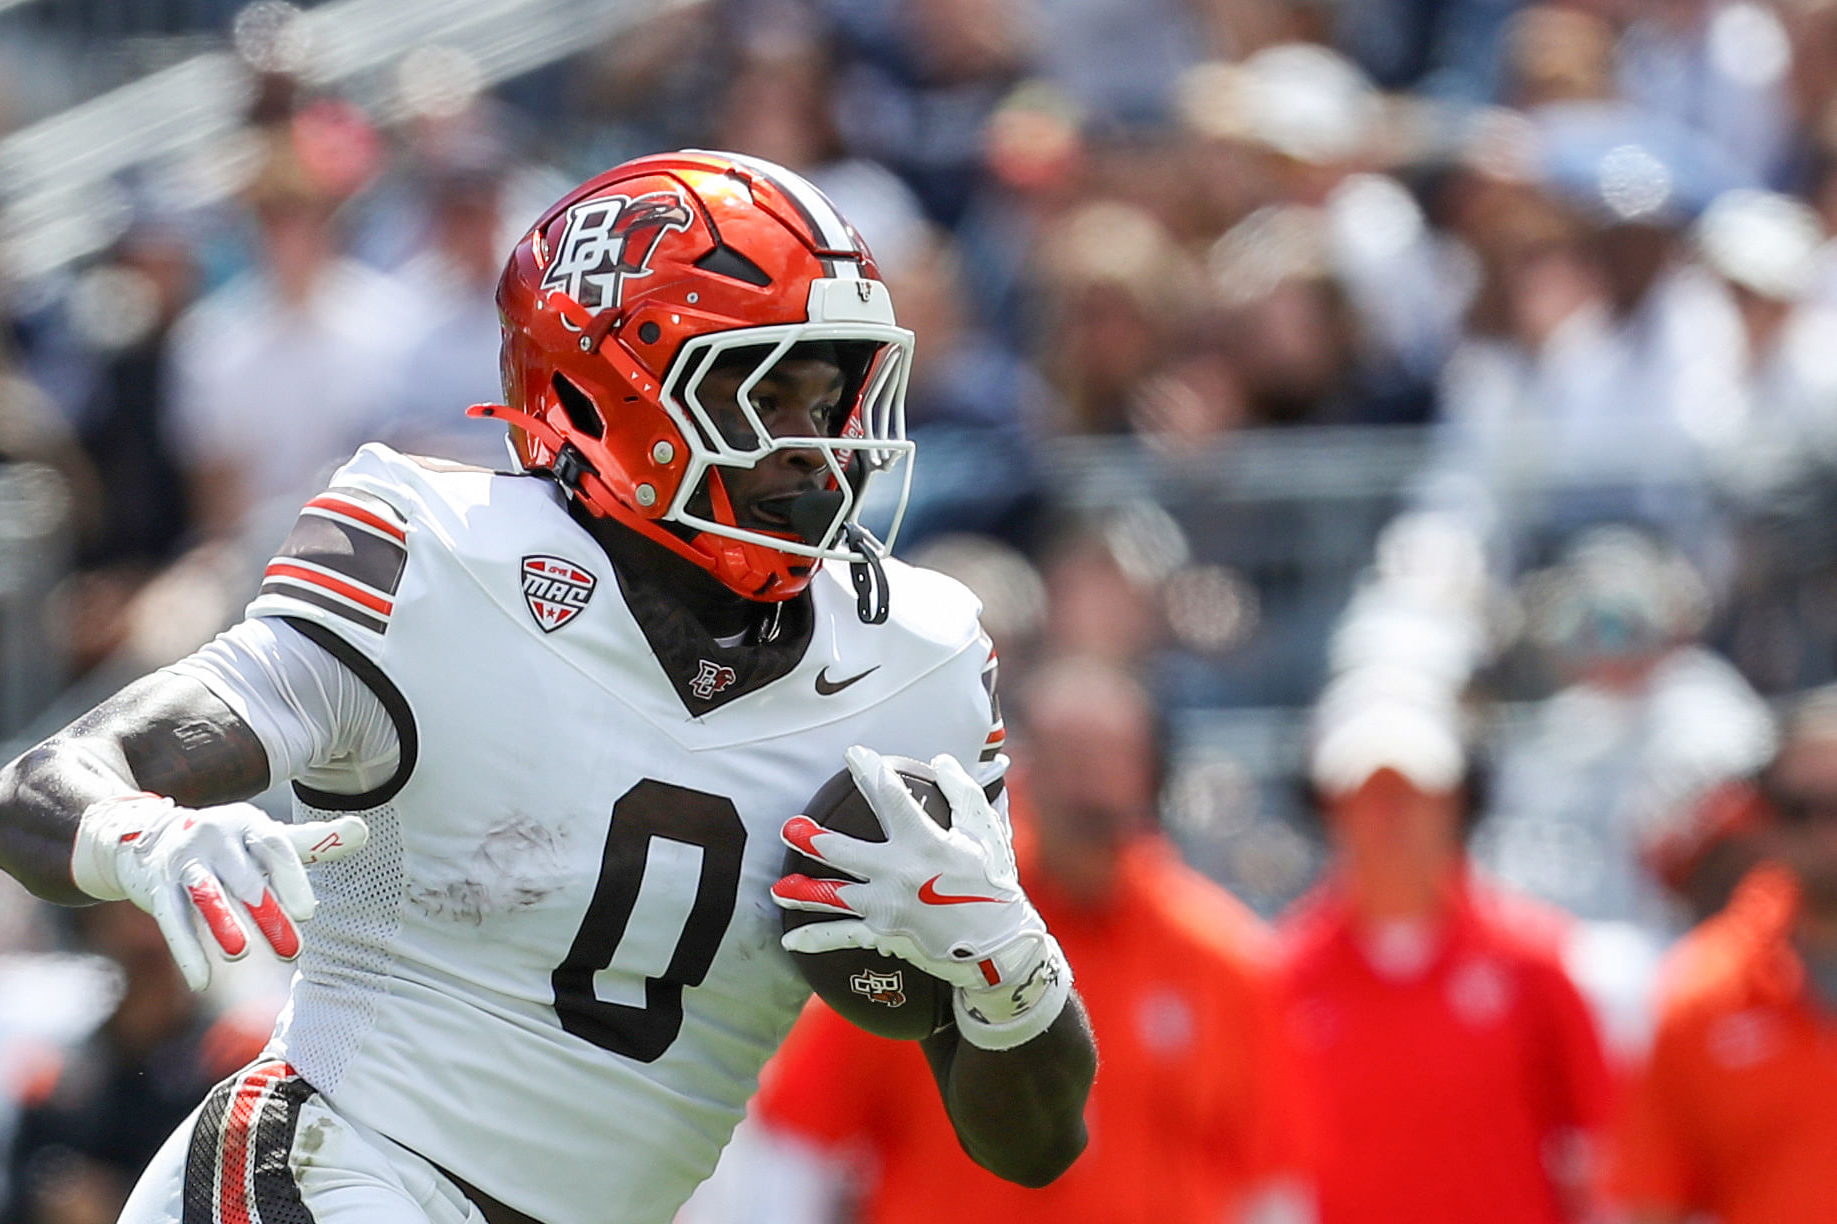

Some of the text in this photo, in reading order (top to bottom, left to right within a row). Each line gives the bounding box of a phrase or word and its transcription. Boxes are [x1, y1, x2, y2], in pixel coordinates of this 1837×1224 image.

[546, 196, 627, 322] BG
[523, 574, 589, 607] MAC
[551, 777, 748, 1064] 0
